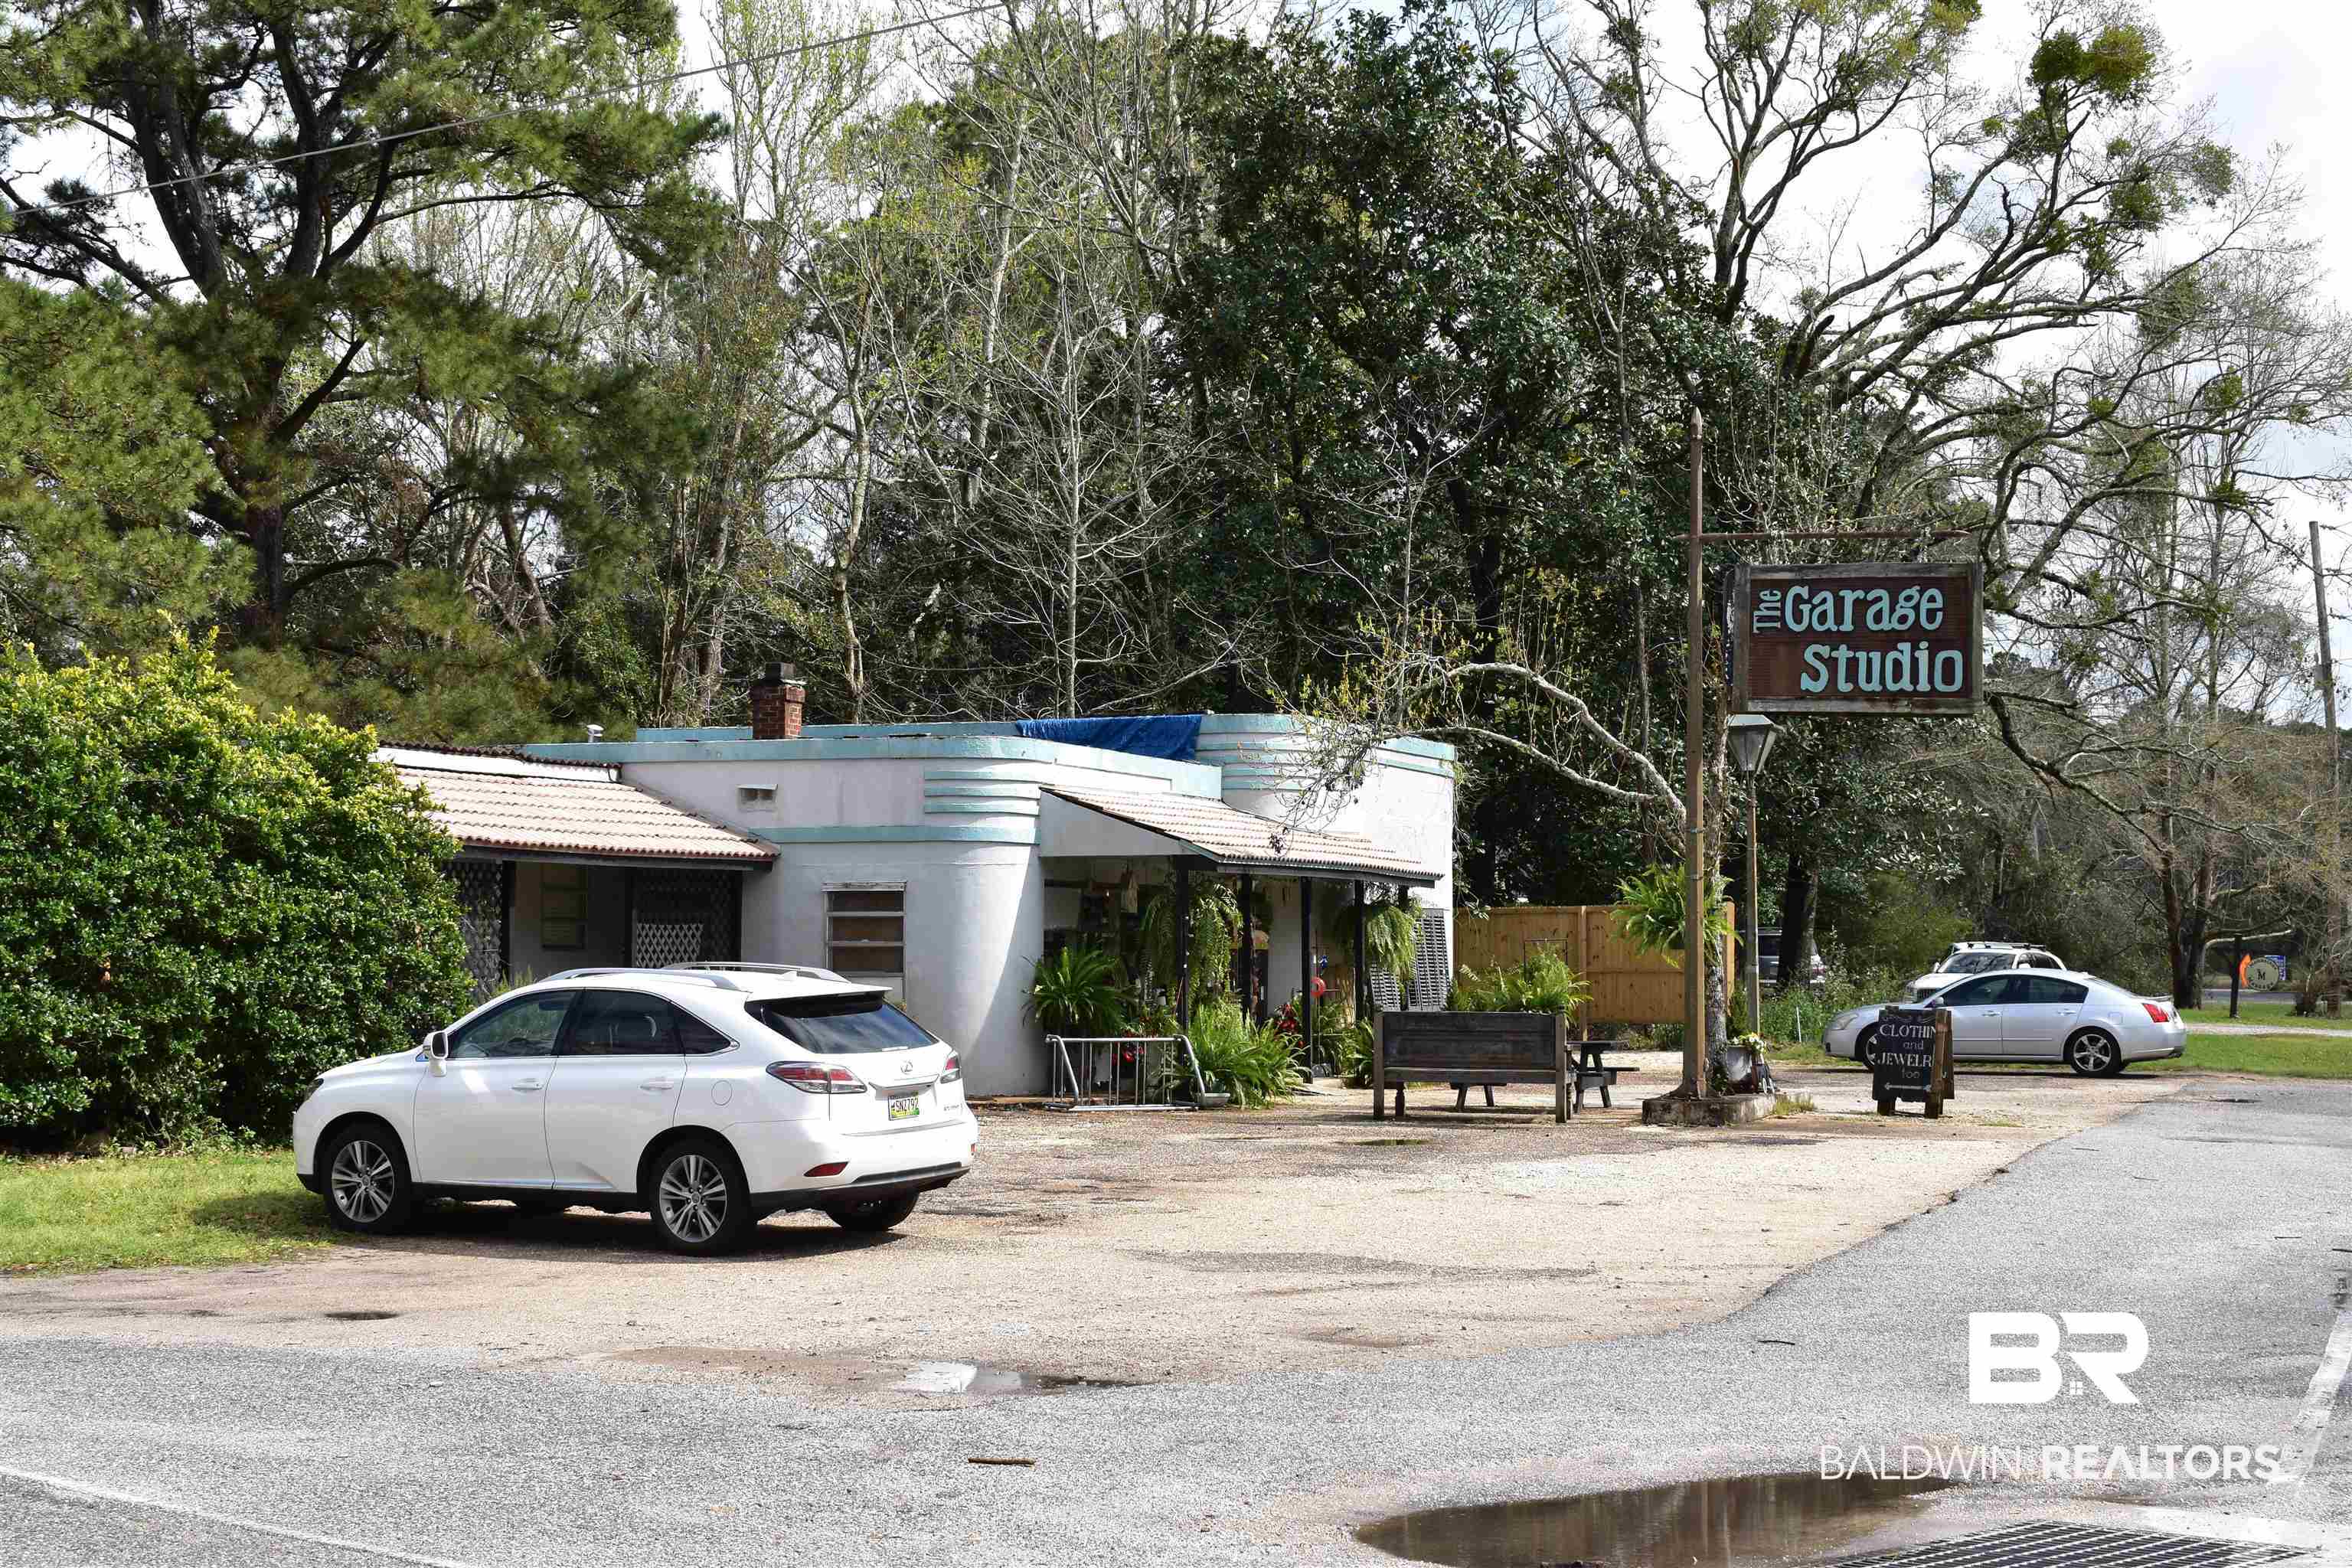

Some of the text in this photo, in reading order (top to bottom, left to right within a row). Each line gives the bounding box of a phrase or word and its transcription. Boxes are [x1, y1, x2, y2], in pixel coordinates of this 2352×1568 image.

[1753, 585, 1944, 634] The Garage
[1800, 641, 1964, 693] Studio
[1880, 1024, 1936, 1039] CLOTHIN
[1903, 1040, 1924, 1050] and
[1877, 1052, 1932, 1067] JEWELR
